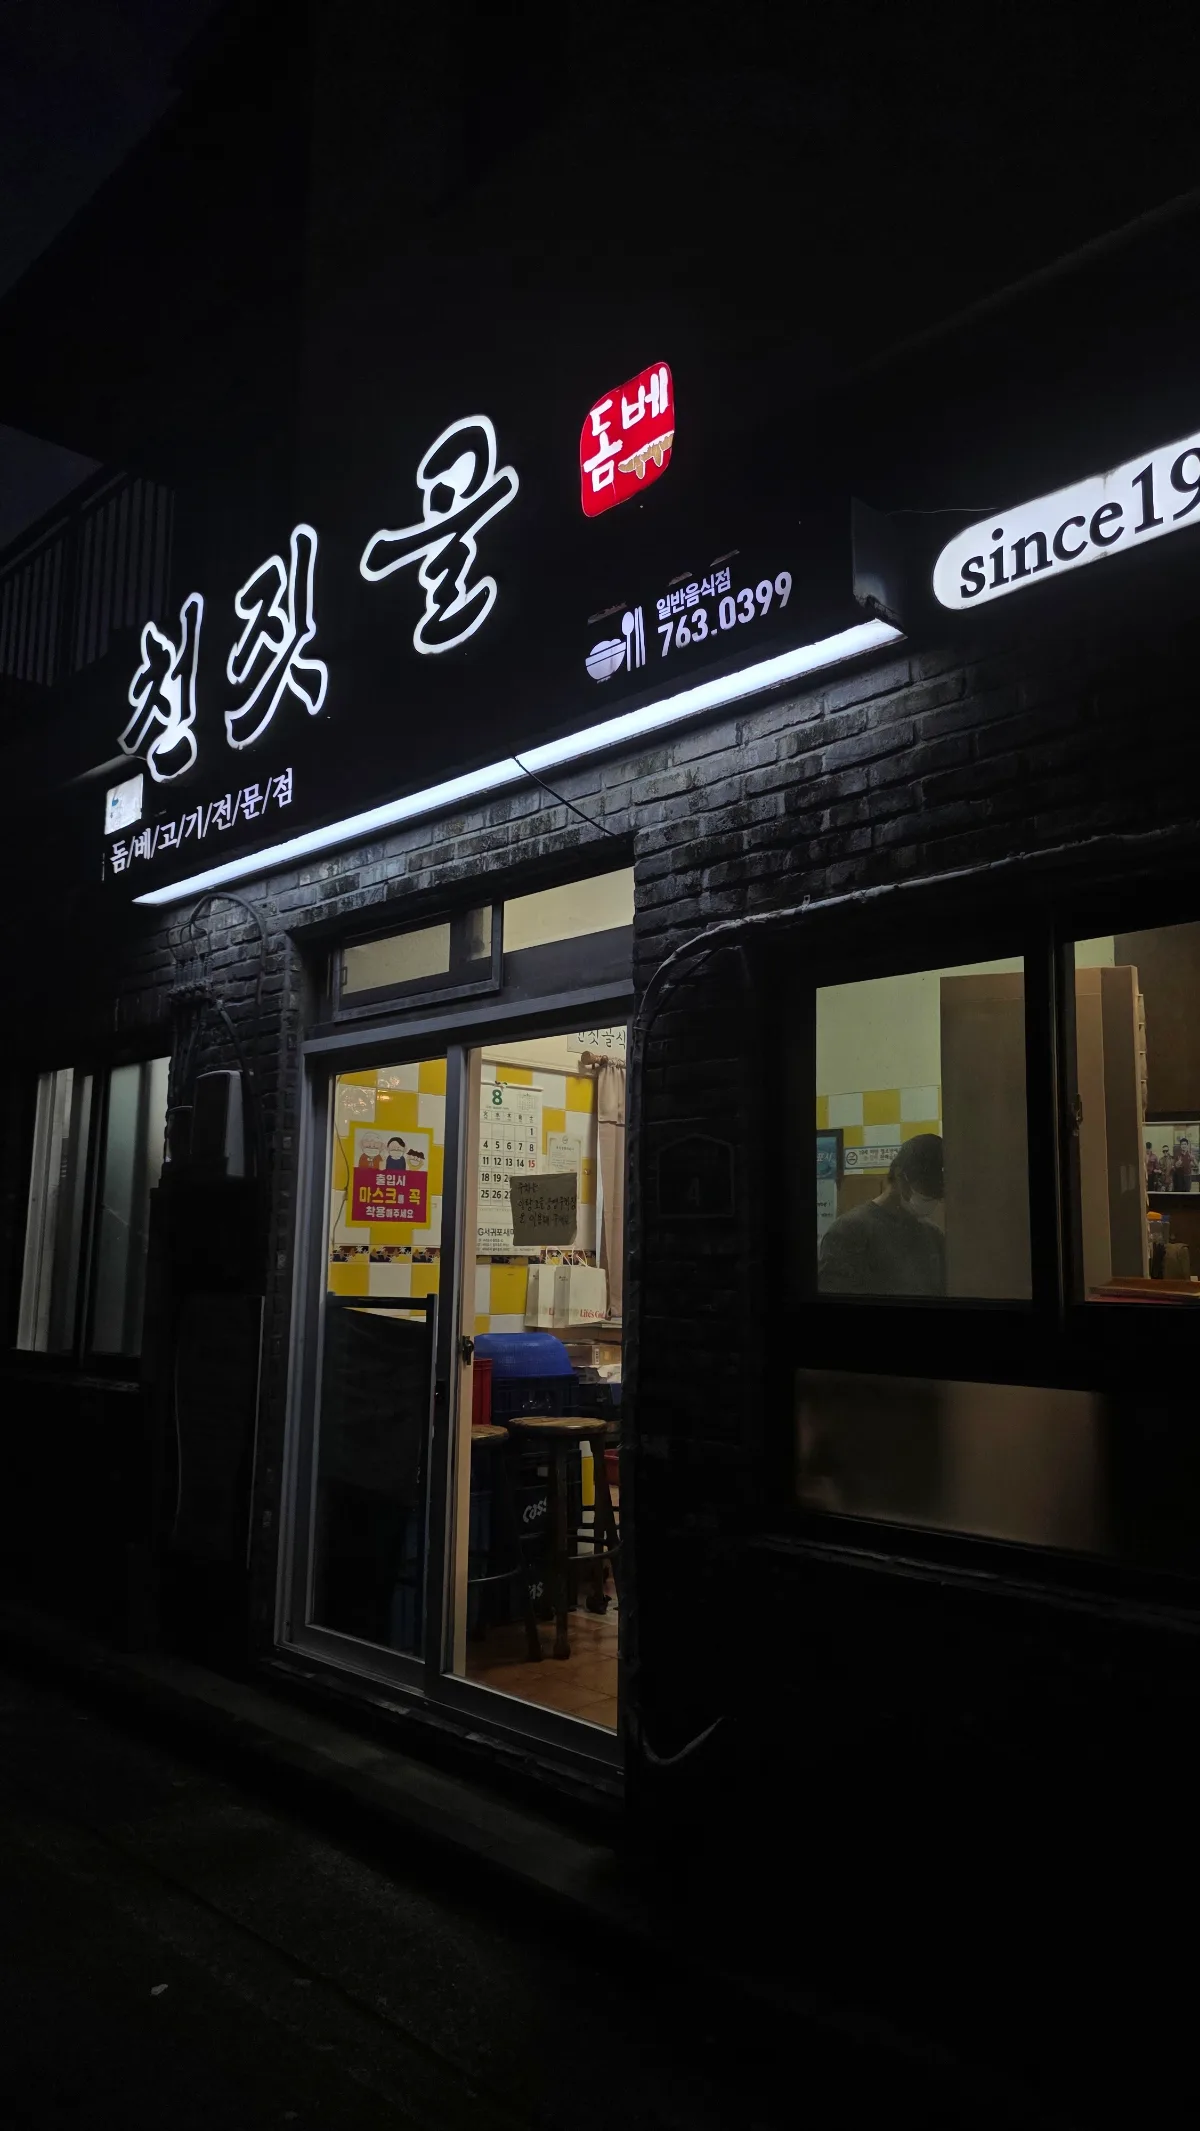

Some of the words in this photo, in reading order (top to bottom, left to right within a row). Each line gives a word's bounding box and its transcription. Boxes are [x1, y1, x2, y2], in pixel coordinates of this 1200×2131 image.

[583, 366, 670, 492] 돔베
[655, 566, 732, 622] 일반음식점
[656, 570, 793, 658] 763.0399
[492, 1089, 503, 1105] 8
[483, 1140, 488, 1148] 4
[495, 1141, 500, 1149] 5
[506, 1142, 512, 1150] 6
[518, 1142, 523, 1151] 7
[529, 1143, 534, 1152] 8
[482, 1156, 489, 1165] 11
[494, 1157, 502, 1166] 12
[505, 1158, 513, 1167] 13
[516, 1159, 524, 1168] 14
[528, 1160, 535, 1168] 15
[375, 1173, 406, 1187] 출입시
[481, 1173, 490, 1182] 18
[493, 1173, 502, 1182] 19
[359, 1186, 405, 1205] 마스크를
[409, 1188, 421, 1206] 꼭
[480, 1190, 490, 1198] 25
[492, 1190, 502, 1199] 26
[365, 1205, 414, 1219] 착용해주세요
